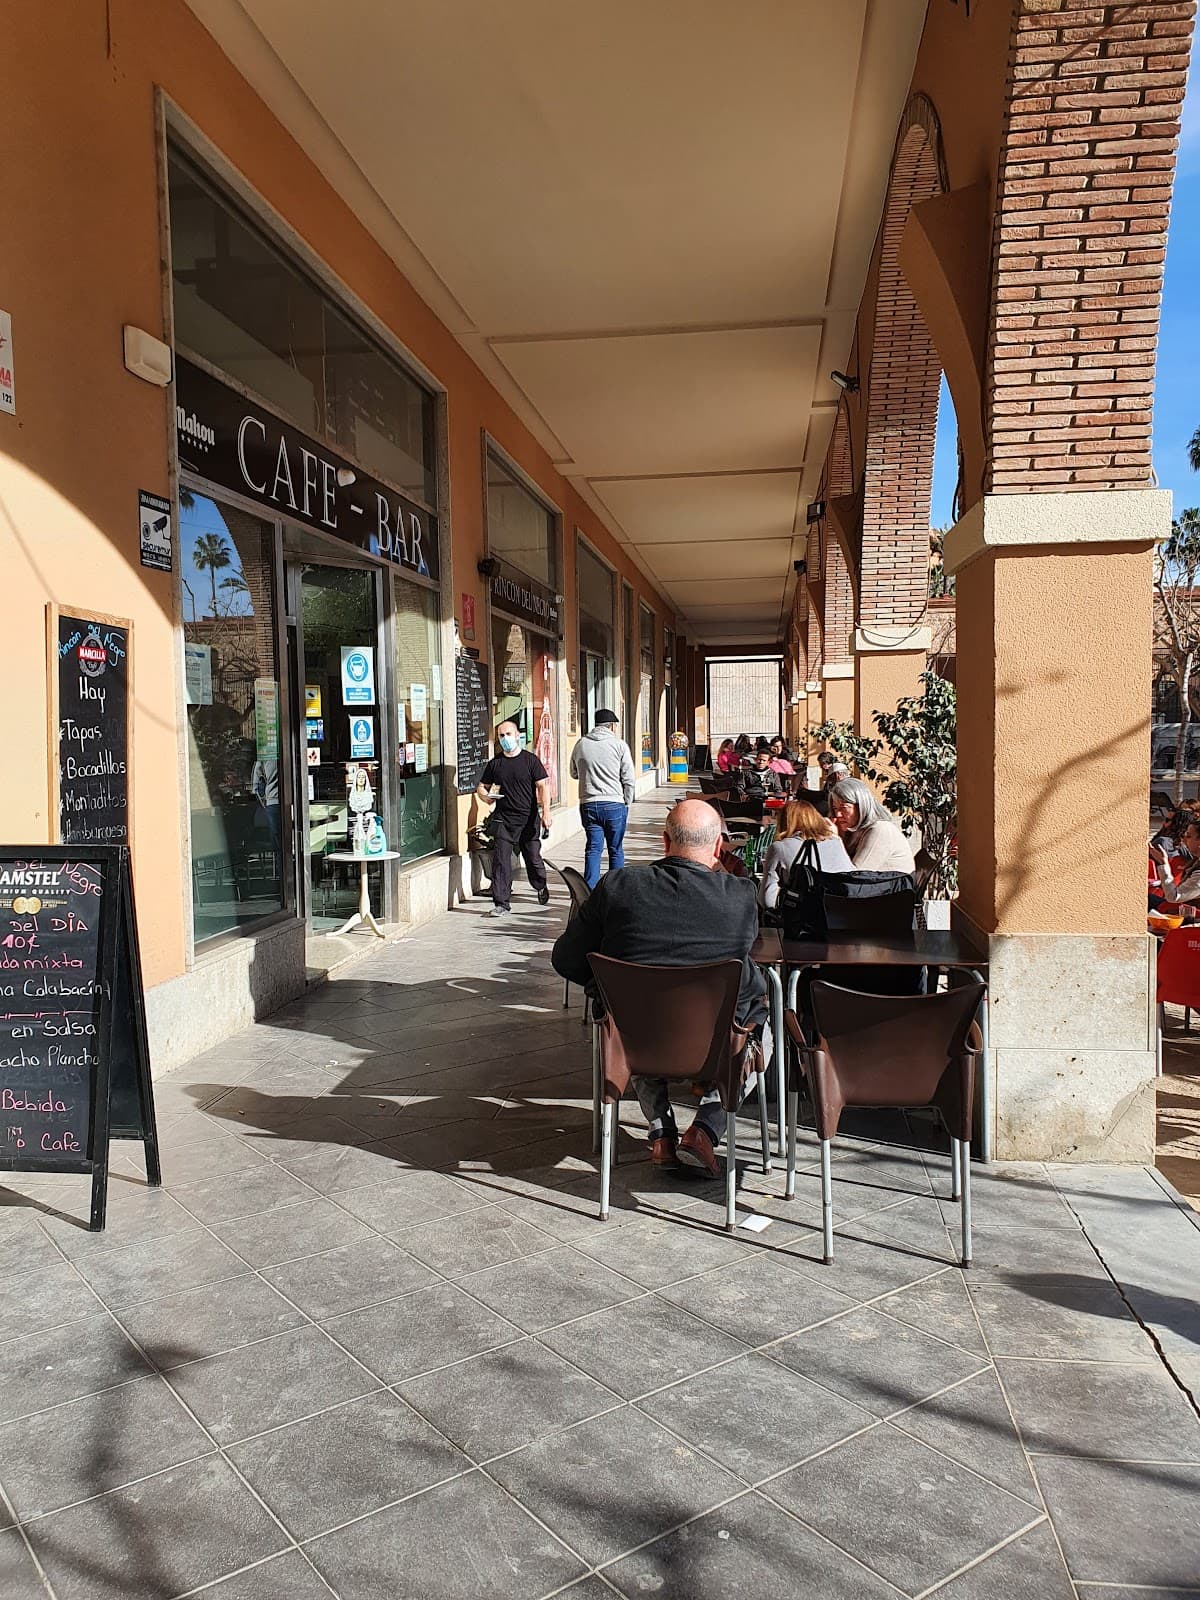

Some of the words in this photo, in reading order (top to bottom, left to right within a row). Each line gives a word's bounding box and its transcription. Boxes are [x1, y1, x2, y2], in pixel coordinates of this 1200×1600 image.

[175, 405, 215, 446] Mahou
[374, 491, 427, 570] BAR
[79, 676, 106, 713] Hay
[62, 719, 102, 752] Tapas
[66, 749, 126, 779] Bocadillos
[65, 780, 127, 812] Montaditos
[0, 871, 61, 886] AMSTEL
[60, 860, 106, 896] Negro
[23, 952, 84, 969] mixta
[11, 1026, 33, 1039] en
[2, 1088, 73, 1112] Bebida
